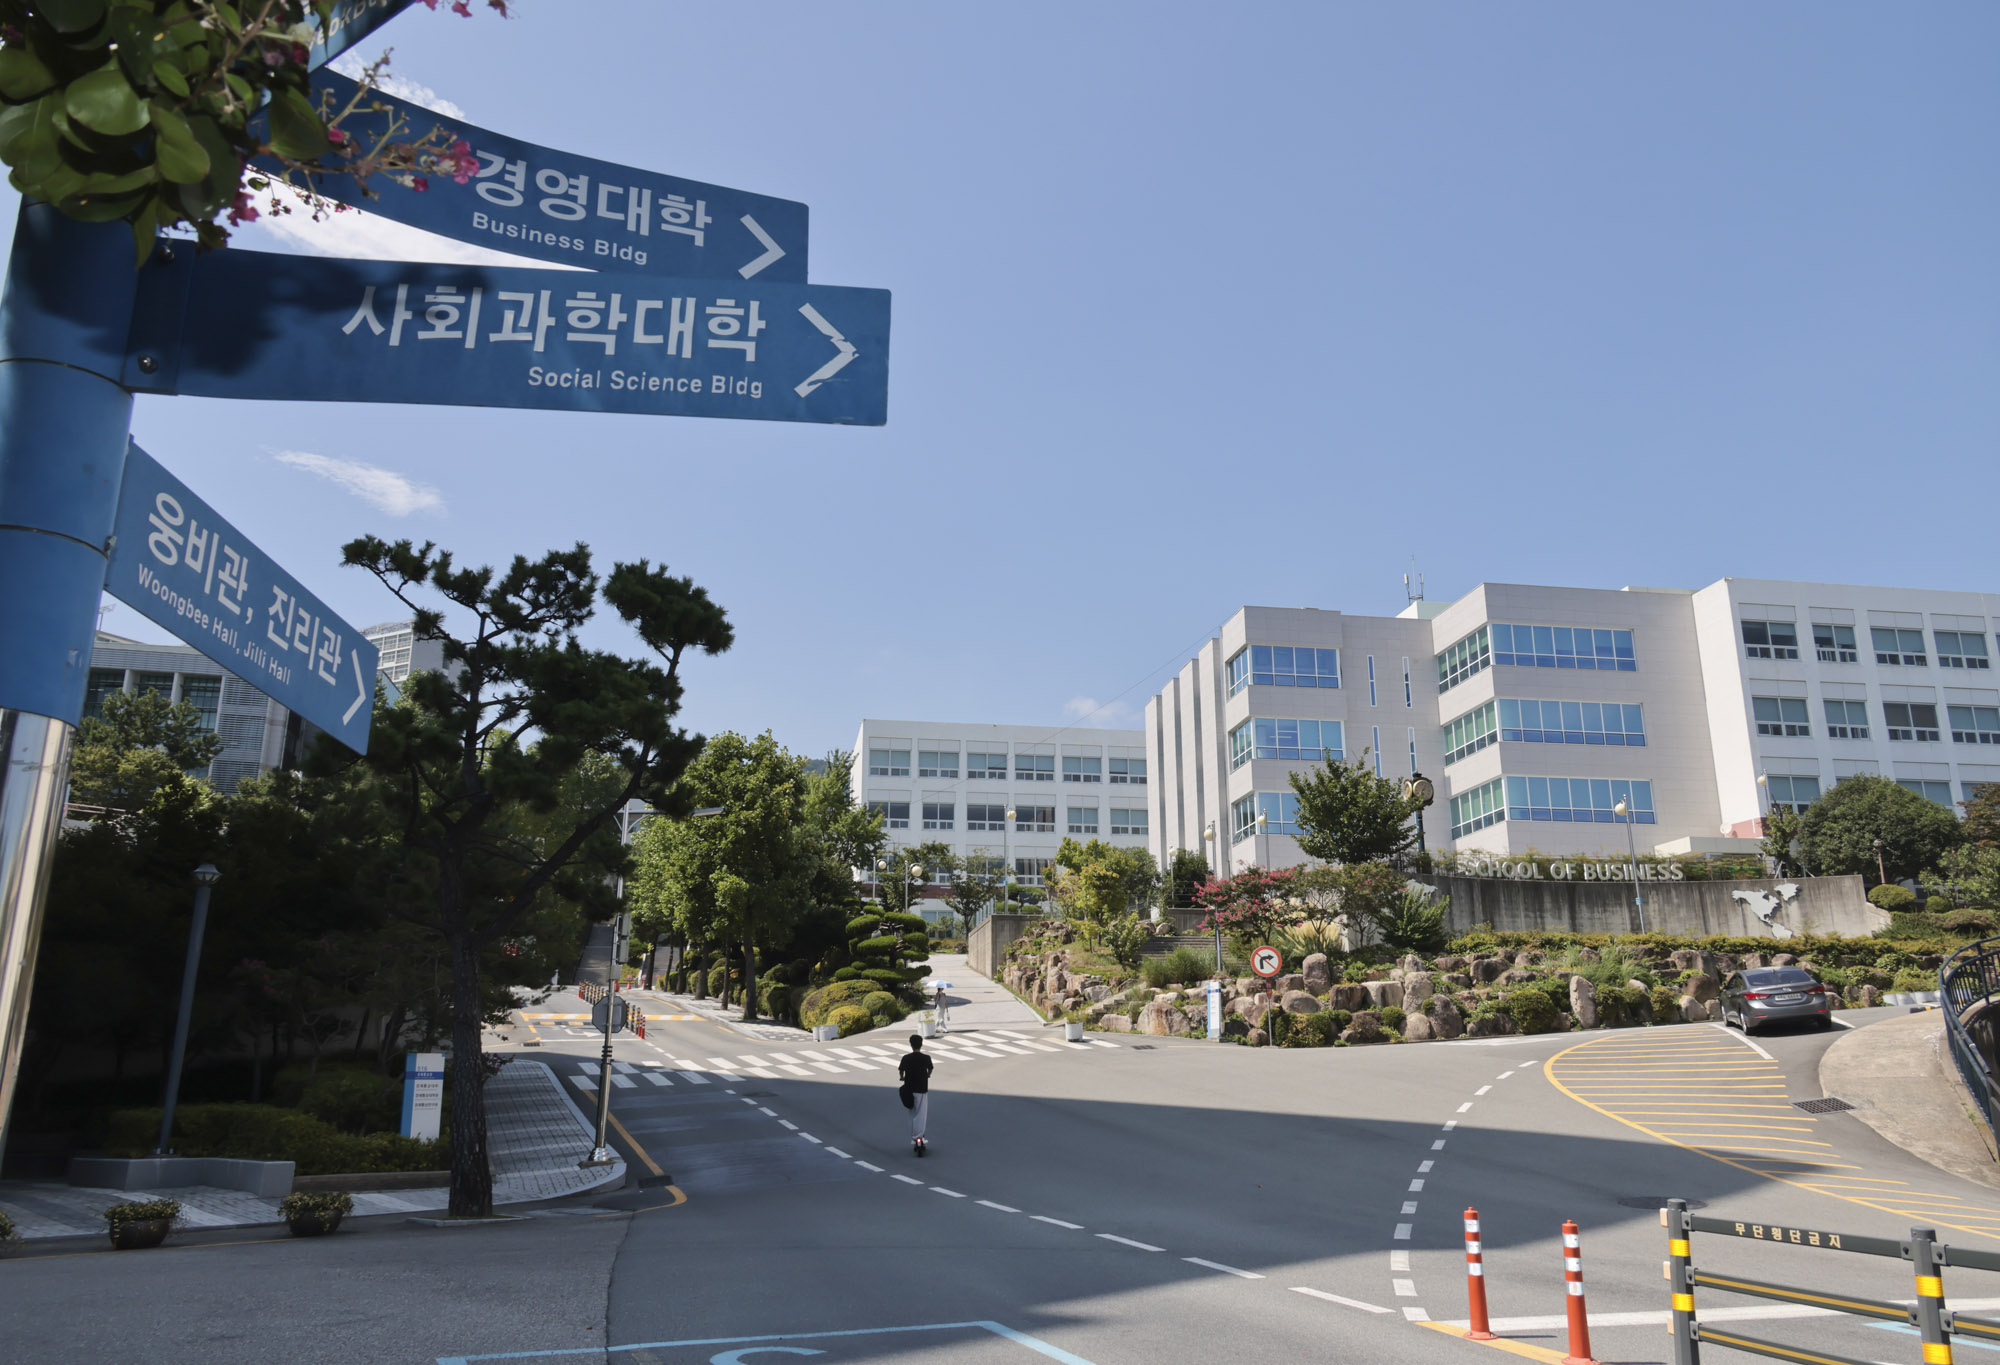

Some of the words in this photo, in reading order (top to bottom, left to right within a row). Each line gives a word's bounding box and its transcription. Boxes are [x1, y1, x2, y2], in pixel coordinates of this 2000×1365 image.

[475, 149, 712, 247] 경영대학
[472, 211, 585, 251] Business
[594, 239, 647, 265] Bldg
[341, 284, 767, 362] 사회과학대학
[527, 366, 601, 389] Social
[610, 370, 702, 393] Science
[712, 376, 763, 398] Bldg
[138, 563, 209, 629] Woongbee
[212, 617, 240, 654] Hall,
[243, 641, 267, 668] Jilli
[268, 656, 291, 685] Hall
[148, 492, 253, 624] 웅비관,
[267, 584, 342, 687] 진리관
[1465, 860, 1544, 880] SCHOOL
[1550, 863, 1576, 881] OF
[1583, 863, 1684, 881] BUSINESS
